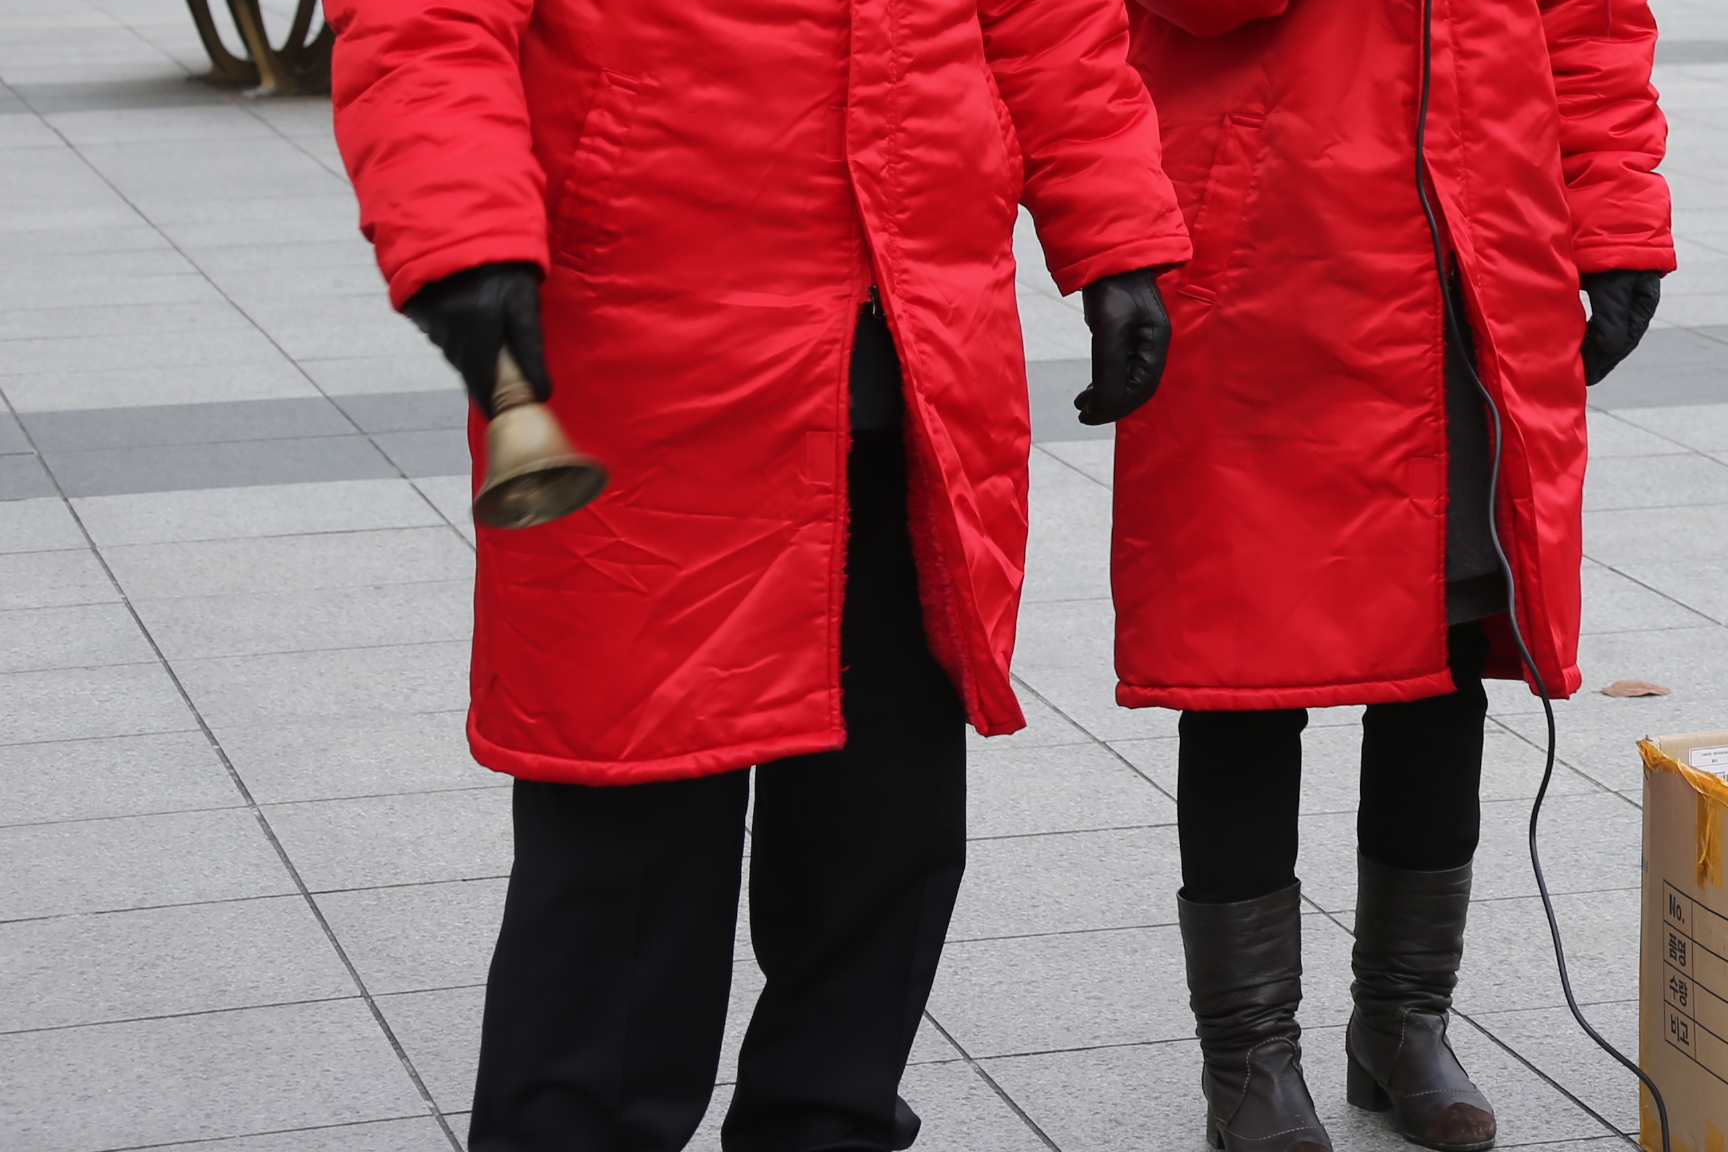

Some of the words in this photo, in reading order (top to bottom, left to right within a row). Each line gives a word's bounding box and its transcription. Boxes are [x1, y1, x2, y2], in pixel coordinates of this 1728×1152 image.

[1669, 894, 1685, 924] No.
[1668, 933, 1687, 967] 품명
[1669, 975, 1688, 1007] 수량
[1670, 1014, 1690, 1046] 비고
